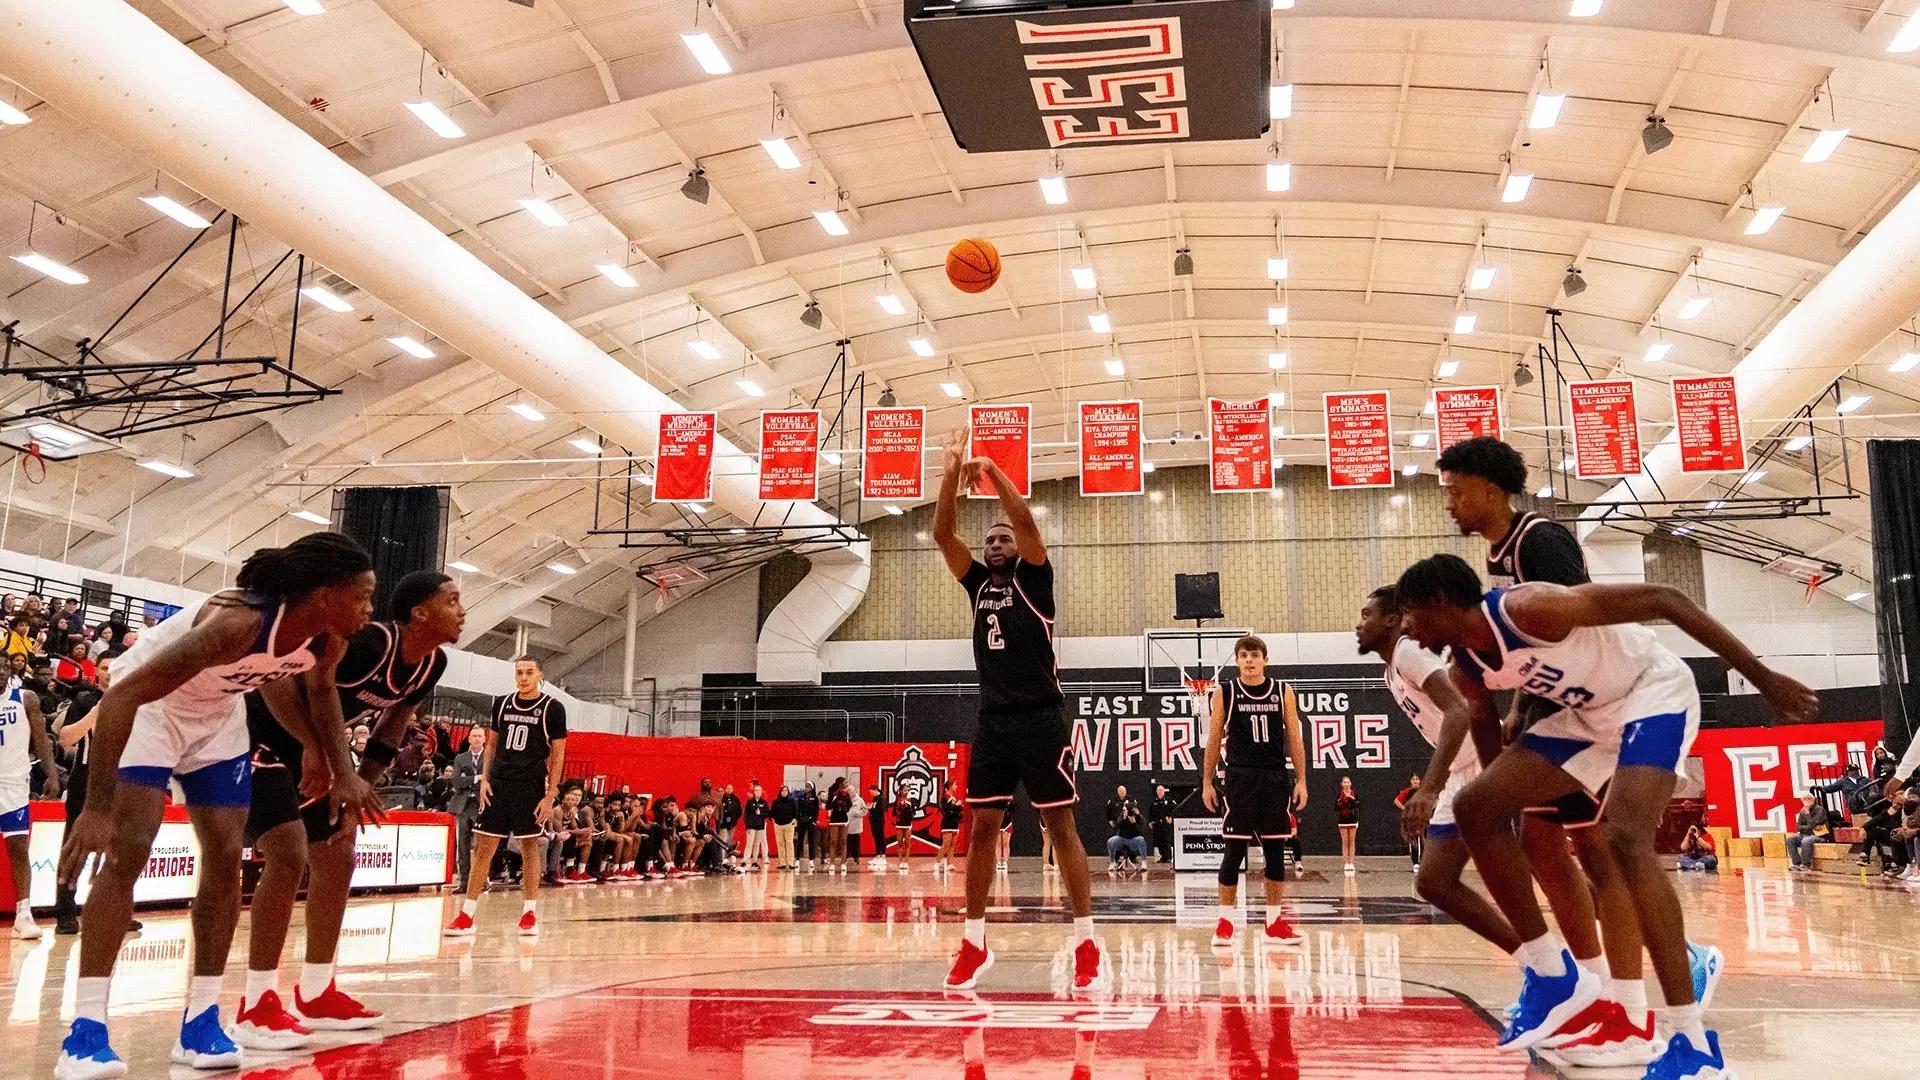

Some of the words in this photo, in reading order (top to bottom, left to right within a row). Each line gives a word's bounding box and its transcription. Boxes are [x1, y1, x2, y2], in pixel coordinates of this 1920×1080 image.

[1014, 16, 1191, 149] ESU
[1676, 382, 1733, 390] GYMNASTICS
[1573, 387, 1631, 395] GYMNASTICS
[1682, 392, 1728, 400] ALL-AMERICA
[1439, 400, 1495, 409] GYMNASTICS
[1579, 397, 1627, 405] ALL-AMERICA
[1220, 402, 1260, 411] ARCHERY
[1330, 405, 1384, 413] GYMNASTICS
[979, 410, 1018, 418] WOMEN'S
[975, 417, 1026, 425] VOLLEYBALL
[986, 613, 1005, 650] 2
[1079, 696, 1143, 716] EAST
[1238, 704, 1279, 712] WARRIORS
[1250, 714, 1270, 743] 11
[505, 724, 529, 751] 10
[1185, 842, 1205, 850] PENN
[354, 852, 393, 869] ARRIORS
